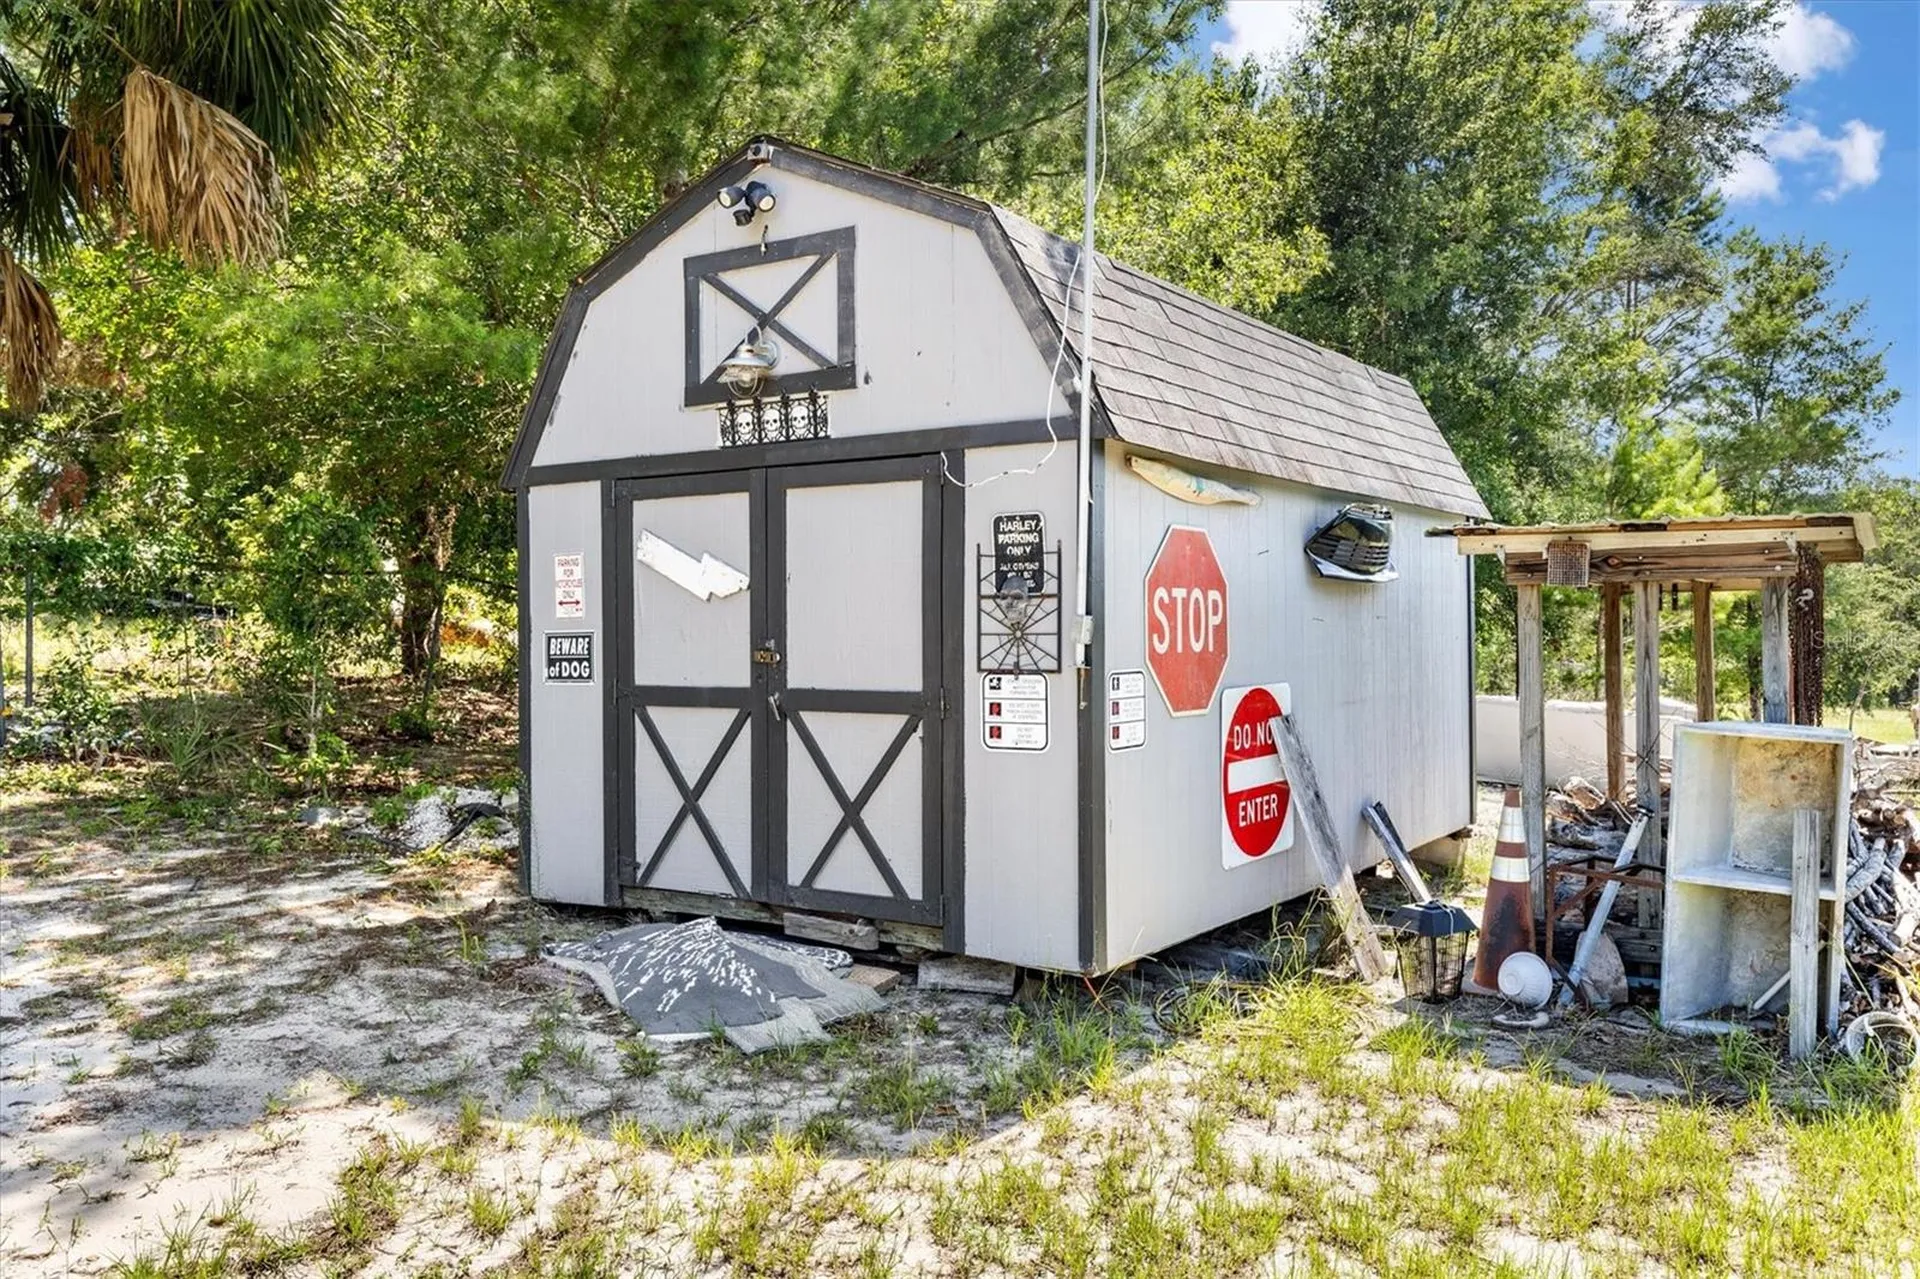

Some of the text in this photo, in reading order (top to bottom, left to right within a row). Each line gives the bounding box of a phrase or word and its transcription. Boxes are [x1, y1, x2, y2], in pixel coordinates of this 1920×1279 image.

[1000, 520, 1037, 532] HARLEY
[998, 533, 1039, 545] PARKING
[1006, 546, 1032, 556] ONLY
[557, 558, 580, 568] PARKING
[1152, 587, 1224, 655] STOP
[549, 637, 590, 656] BEWARE
[549, 660, 590, 678] of DOG
[1233, 719, 1275, 752] DO NO
[1238, 793, 1278, 828] ENTER
